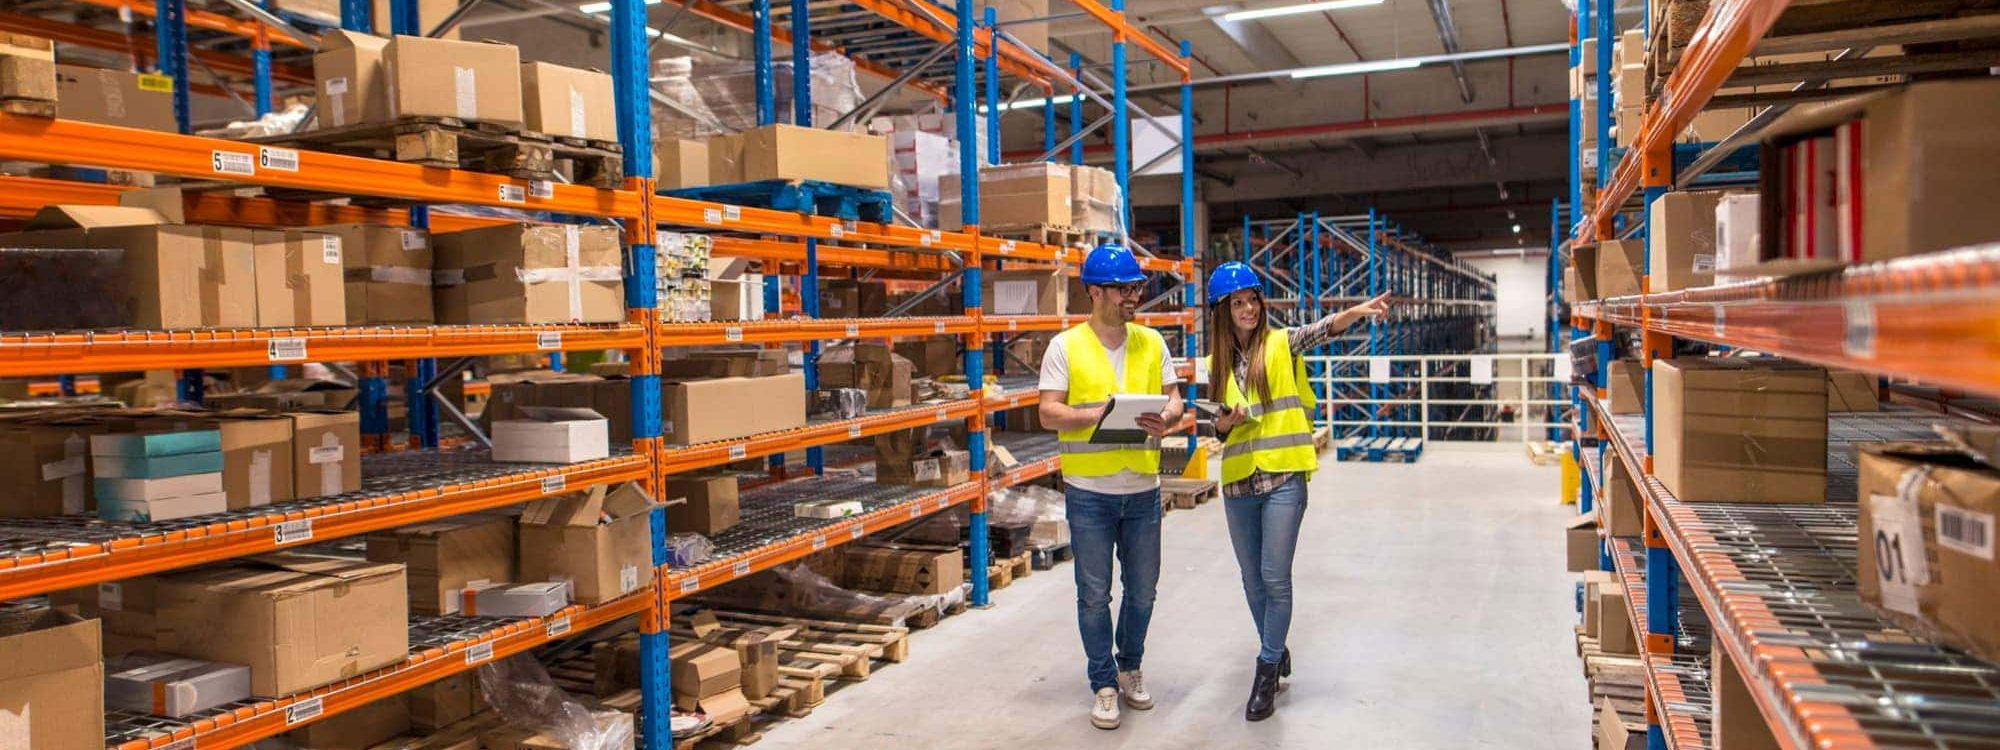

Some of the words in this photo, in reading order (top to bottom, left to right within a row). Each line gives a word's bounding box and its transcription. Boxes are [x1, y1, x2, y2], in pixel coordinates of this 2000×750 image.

[214, 152, 222, 170] 5
[262, 149, 268, 166] 6
[270, 341, 276, 358] 4
[276, 525, 282, 541] 3
[1876, 529, 1907, 584] 01
[287, 707, 294, 723] 2
